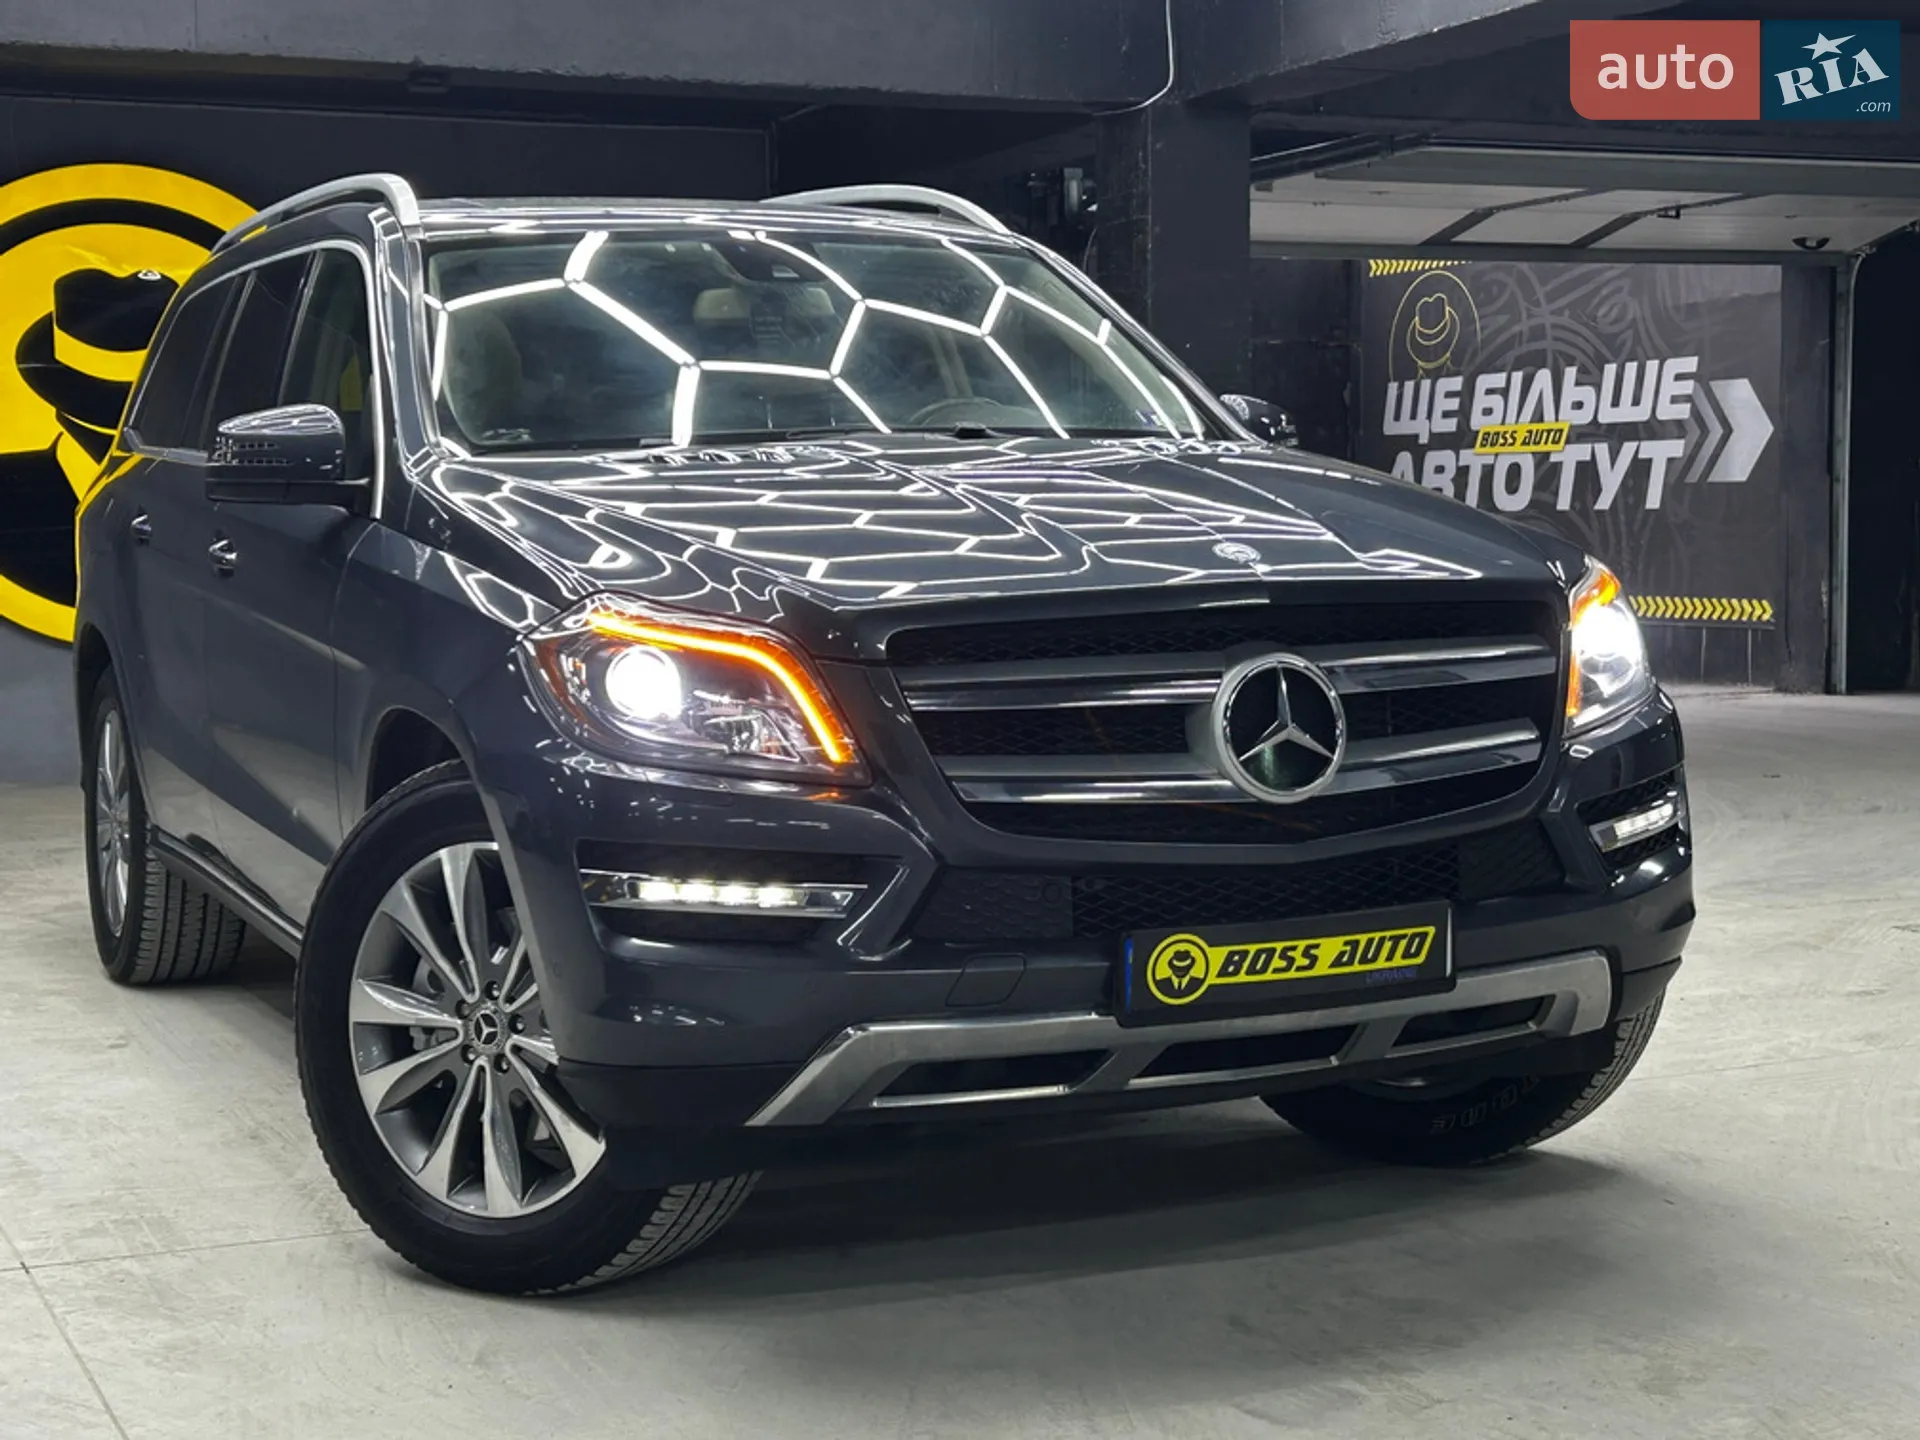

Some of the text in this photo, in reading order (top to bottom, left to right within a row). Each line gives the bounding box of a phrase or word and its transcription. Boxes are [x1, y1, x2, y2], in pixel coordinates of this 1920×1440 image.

[1383, 356, 1698, 444] ЩЕ БІЛЬШЕ
[1479, 428, 1564, 448] BOSS AUTO
[1550, 440, 1684, 511] ТУТ
[1216, 943, 1321, 978] BOSS
[1328, 931, 1430, 969] AUTO
